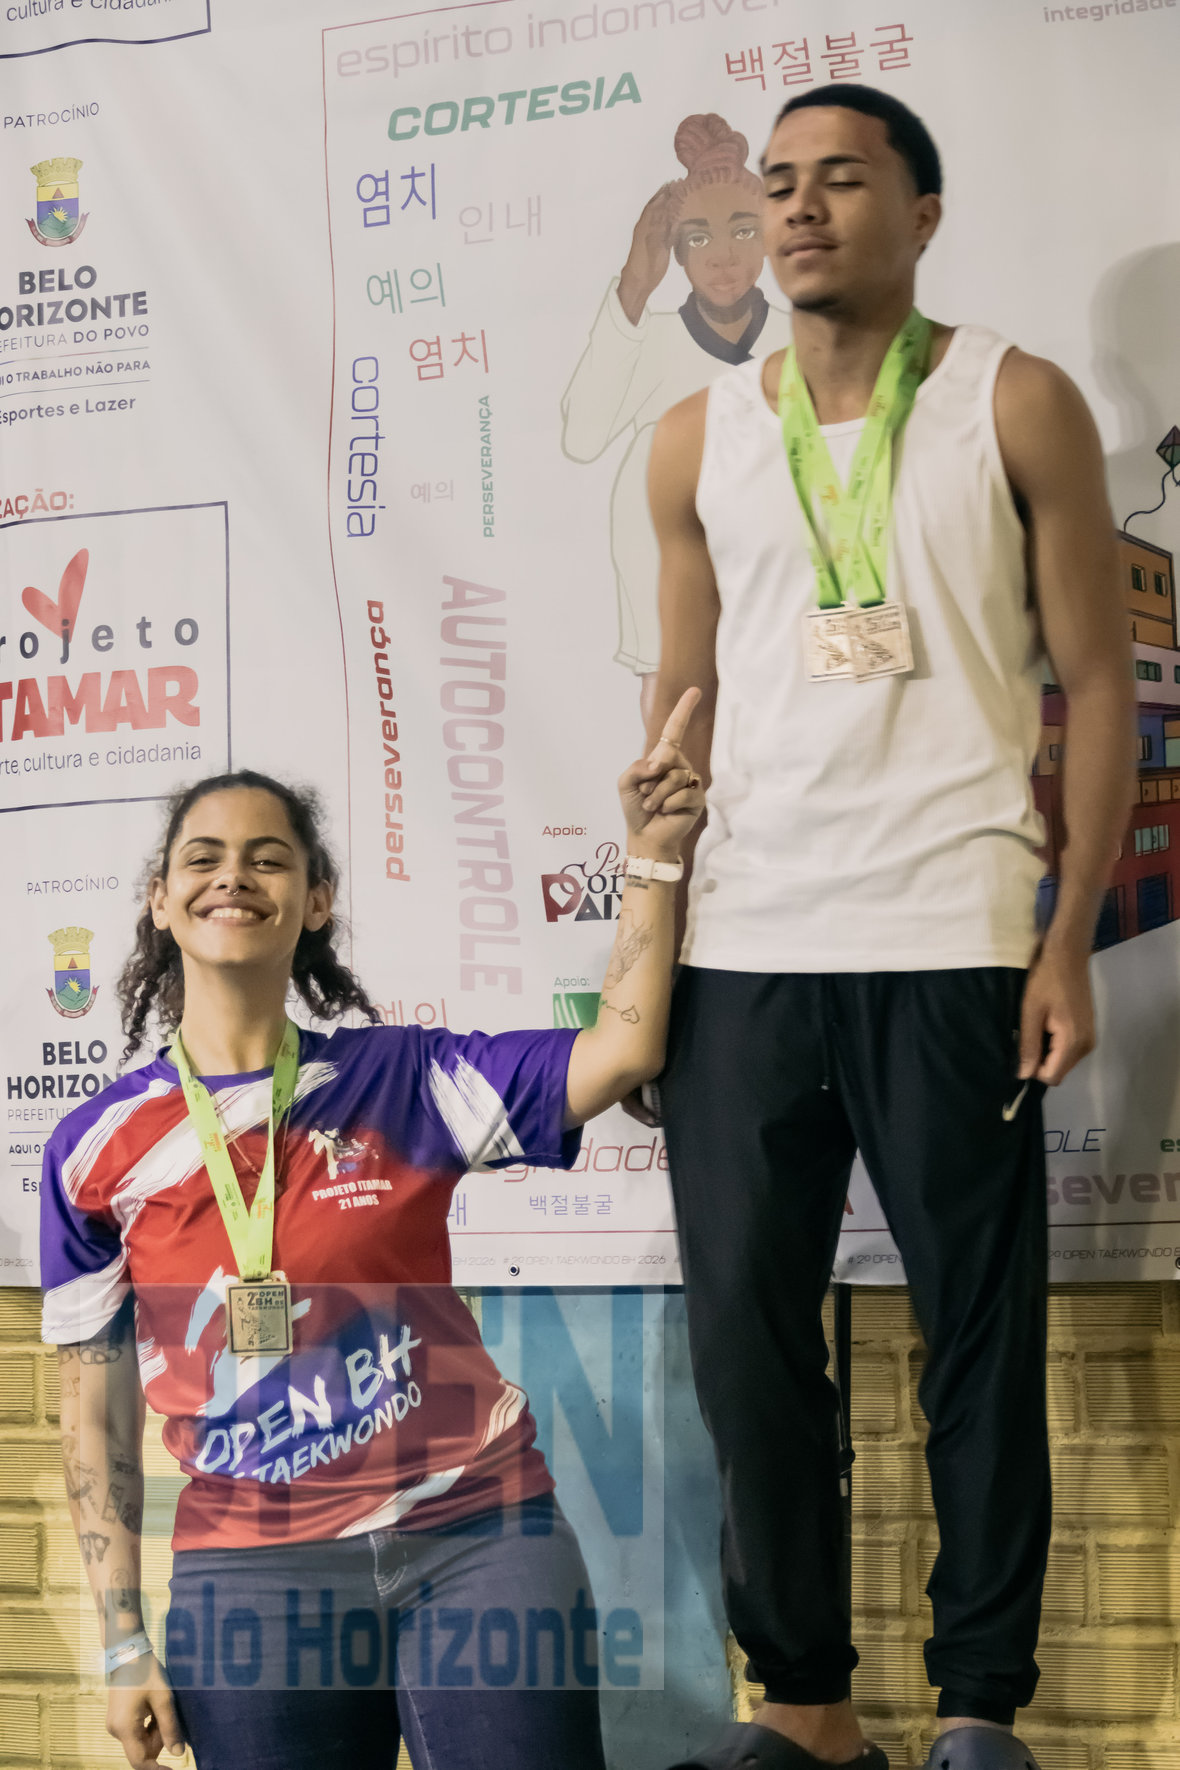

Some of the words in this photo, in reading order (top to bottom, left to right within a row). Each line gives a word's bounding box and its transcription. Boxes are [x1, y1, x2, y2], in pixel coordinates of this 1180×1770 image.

[6, 0, 65, 21] cultura
[337, 20, 513, 79] espírito
[725, 23, 915, 91] 백절불굴
[3, 102, 100, 129] PATROCÍNIO
[387, 72, 642, 141] CORTESIA
[356, 162, 438, 228] 염치
[458, 195, 543, 245] 인내
[18, 265, 97, 295] BELO
[366, 262, 447, 315] 예의
[0, 333, 68, 354] FEITURA
[73, 329, 98, 344] DO
[104, 324, 149, 340] POVO
[409, 329, 489, 381] 염치
[16, 366, 83, 382] TRABALHO
[86, 361, 114, 375] NÃO
[116, 360, 151, 373] PARA
[0, 404, 65, 426] sportes
[69, 403, 80, 415] e
[85, 398, 136, 413] Lazer
[347, 356, 387, 538] cortesia
[478, 395, 496, 538] PERSEVERANÇA
[0, 487, 75, 519] AÇÃO:
[410, 480, 454, 504] 예의
[367, 599, 412, 883] perseverança
[23, 749, 83, 773] cultura
[88, 750, 100, 766] e
[105, 742, 202, 766] cidadania
[439, 574, 524, 996] AUTOCONTROLE
[542, 824, 588, 838] Apoio:
[26, 874, 120, 895] PATROCÍNIO
[553, 974, 591, 988] Apoio:
[42, 1040, 108, 1066] BELO
[9, 1143, 32, 1154] AQUI
[312, 1181, 357, 1201] PROJETO
[357, 1179, 393, 1191] ITAMAR
[338, 1197, 352, 1211] 21
[352, 1193, 380, 1208] ANOS
[529, 1193, 614, 1217] 백절불굴
[556, 1254, 621, 1266] TAEKWONDO
[638, 1254, 667, 1265] 2026
[1096, 1247, 1172, 1259] TAEKWONDO
[195, 1374, 335, 1474] OPEN
[344, 1323, 423, 1411] BH
[255, 1381, 423, 1485] TAEKWONDO
